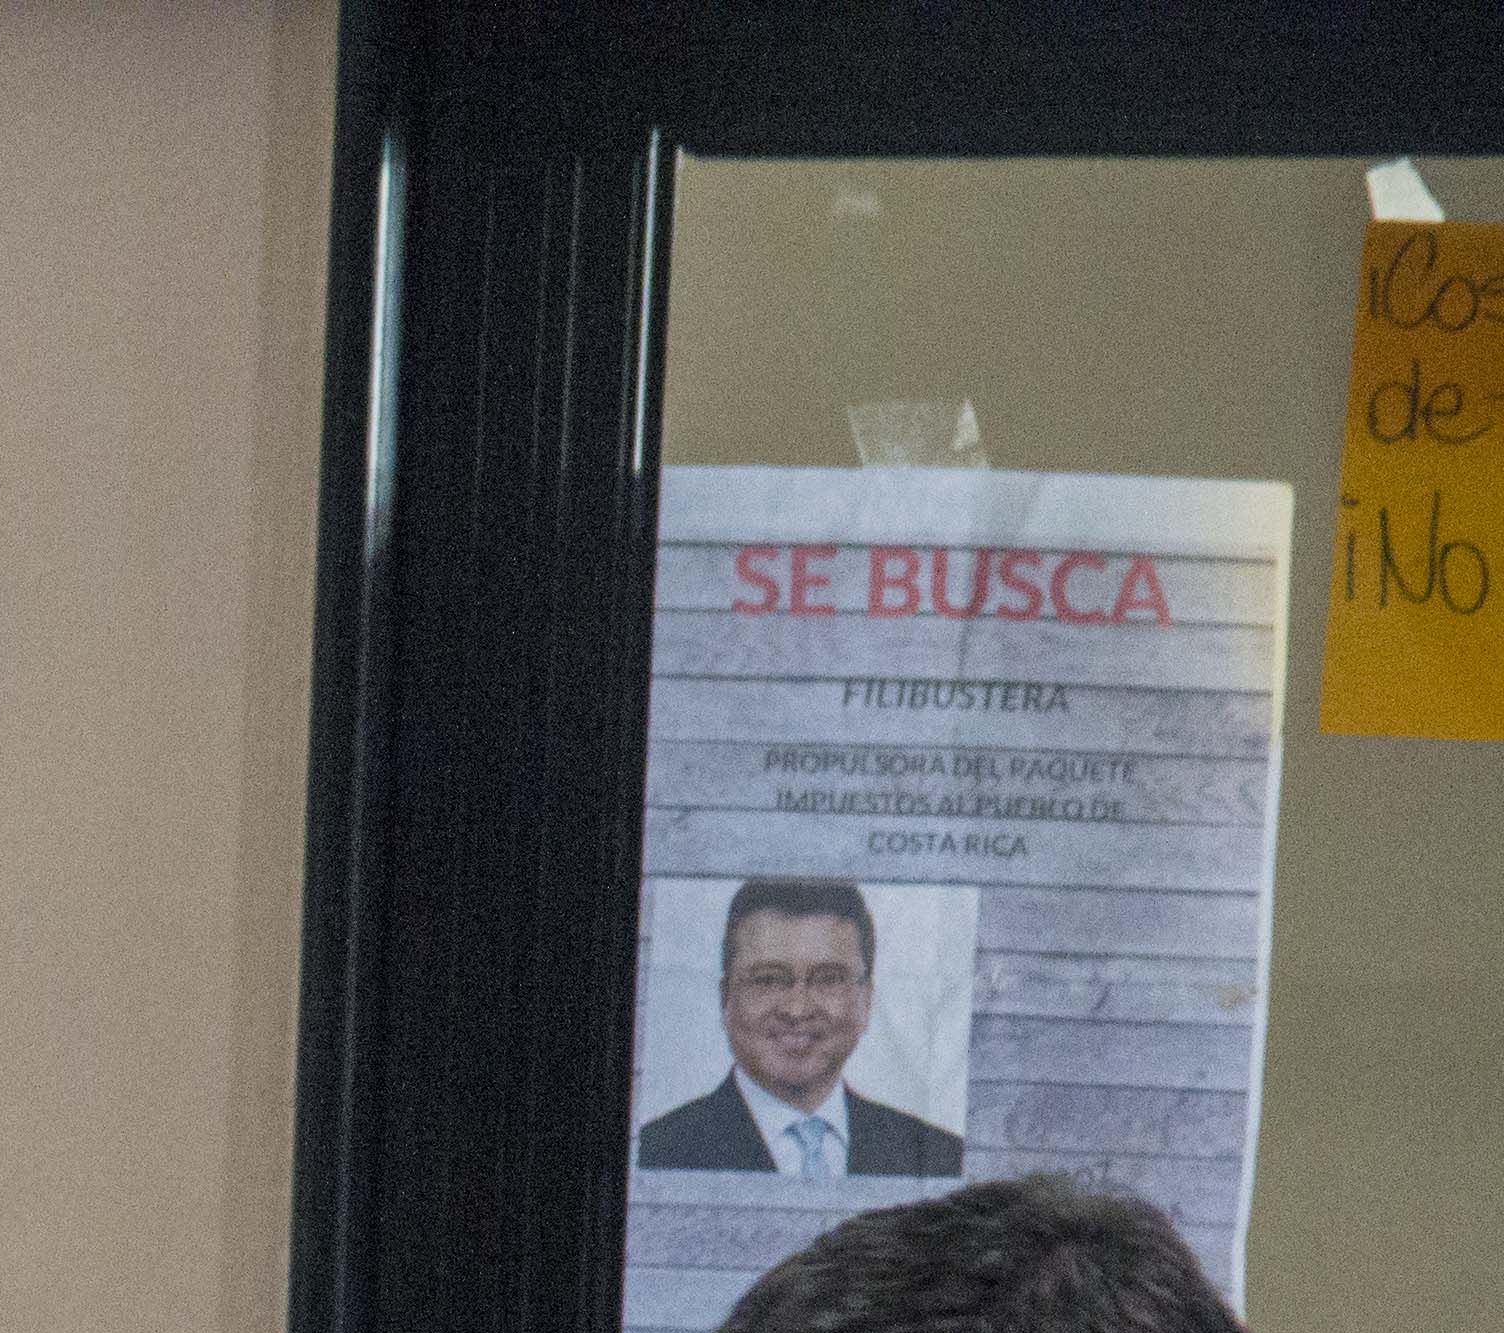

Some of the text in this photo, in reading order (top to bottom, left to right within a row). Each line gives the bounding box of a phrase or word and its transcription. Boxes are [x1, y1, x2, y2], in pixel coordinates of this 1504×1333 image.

[1368, 357, 1494, 443] de
[733, 544, 1171, 628] SE BUSCA
[842, 679, 1069, 712] FILIBUSTERA
[764, 749, 1136, 785] PROPULSORA DEL PAQUETE
[777, 789, 930, 816] IMPUESTOS
[868, 831, 1028, 858] COSTA RICA
